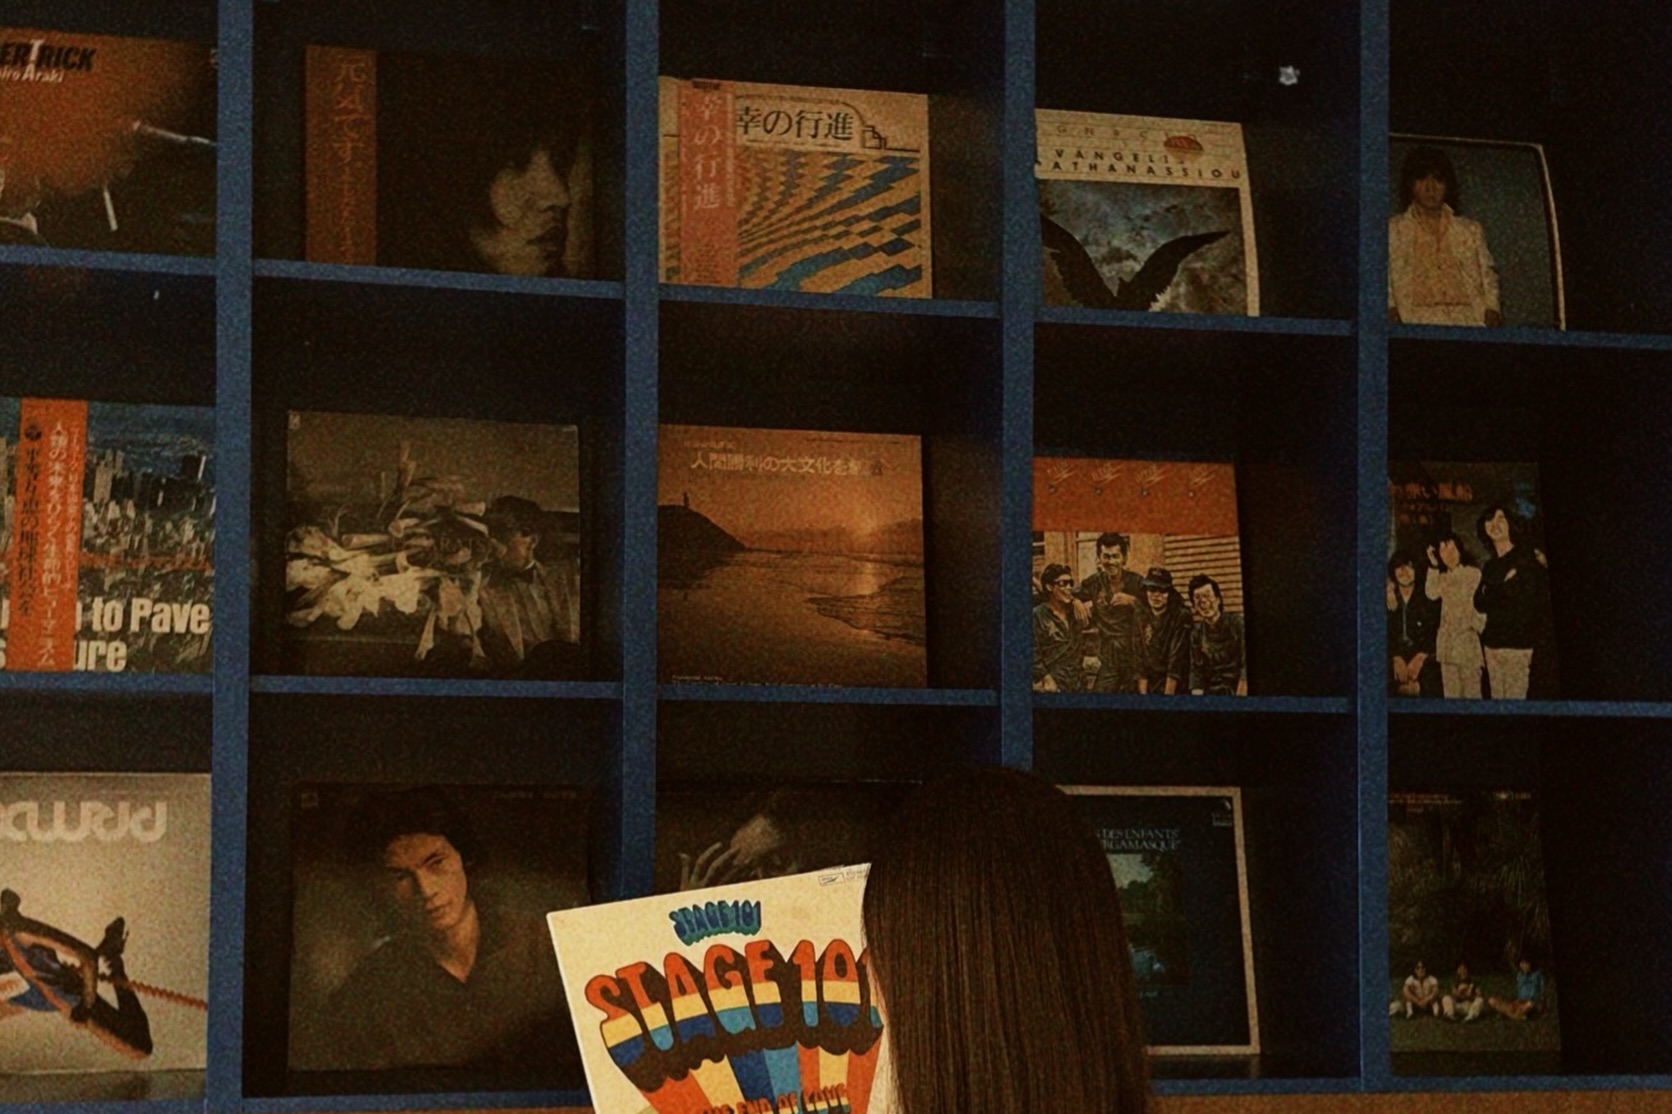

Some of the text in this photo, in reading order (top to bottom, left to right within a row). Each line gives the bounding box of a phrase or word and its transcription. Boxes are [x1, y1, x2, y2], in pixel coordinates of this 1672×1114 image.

[21, 63, 65, 83] Araki
[93, 597, 124, 633] to
[131, 597, 211, 634] Pave
[584, 938, 790, 1092] STAGE
